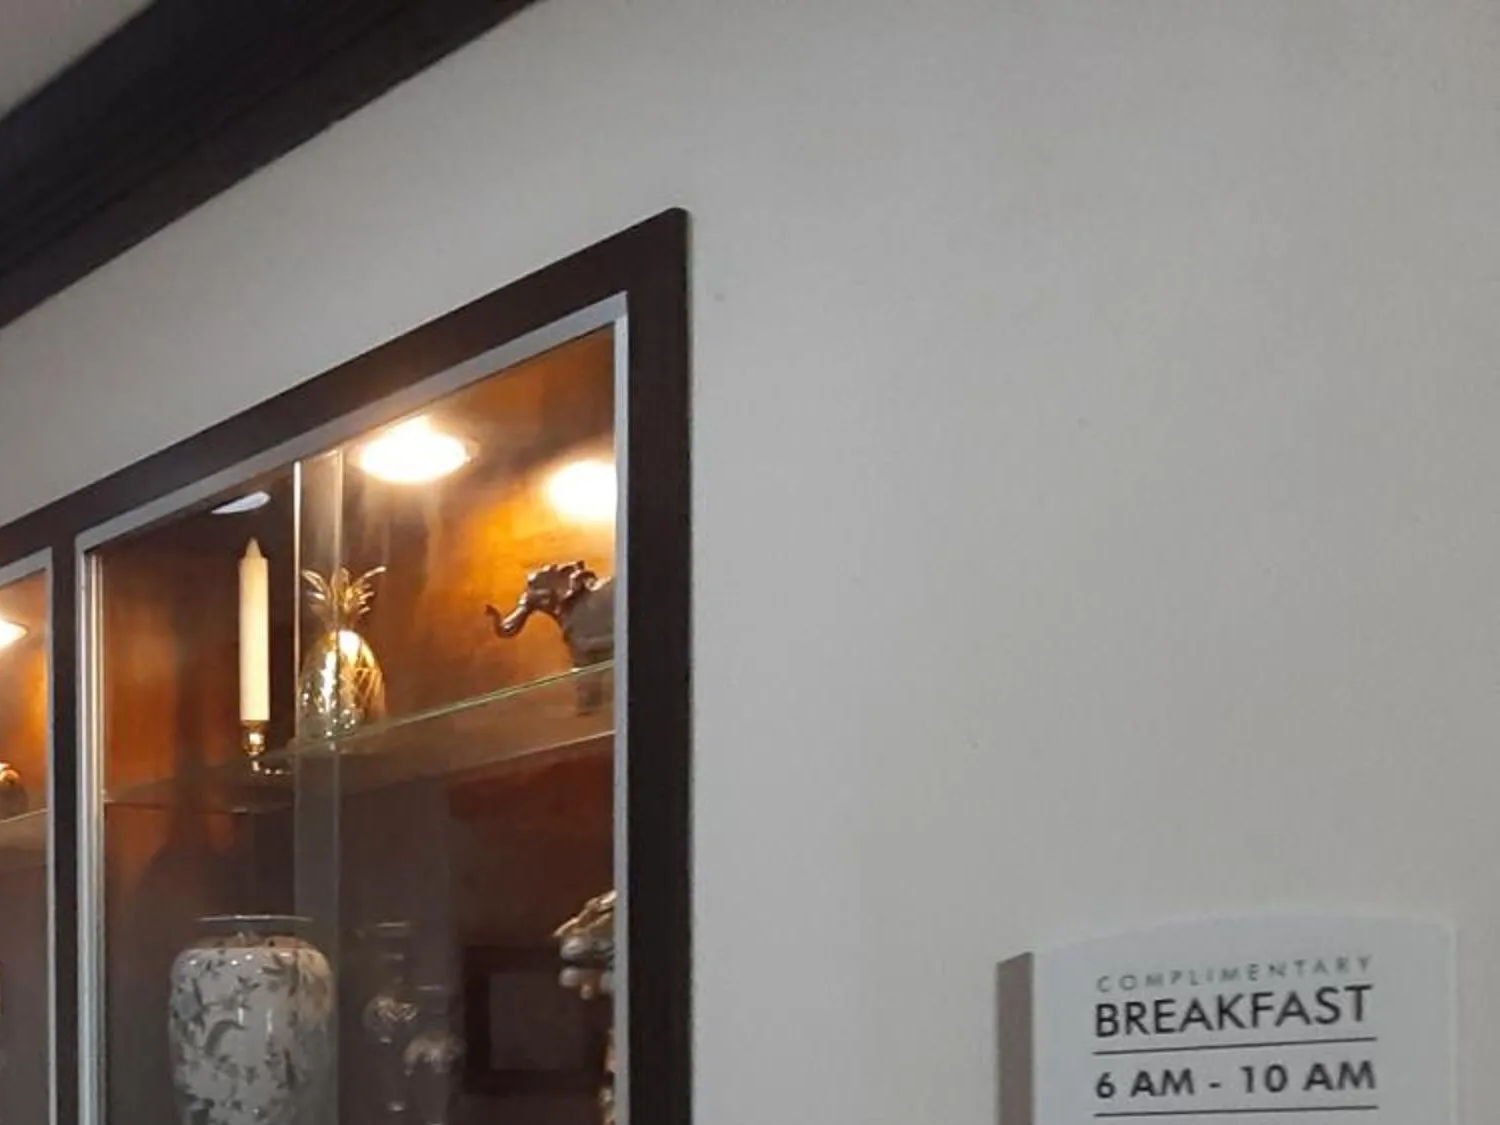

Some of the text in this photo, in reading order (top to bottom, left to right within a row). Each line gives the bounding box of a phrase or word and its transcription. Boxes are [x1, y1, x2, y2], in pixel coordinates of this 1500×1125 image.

[1097, 956, 1372, 993] COMPLIMENTARY
[1096, 985, 1372, 1037] BREAKFAST
[1096, 1072, 1115, 1099] 6
[1130, 1069, 1194, 1097] AM
[1241, 1065, 1288, 1093] 10
[1304, 1060, 1376, 1090] AM
